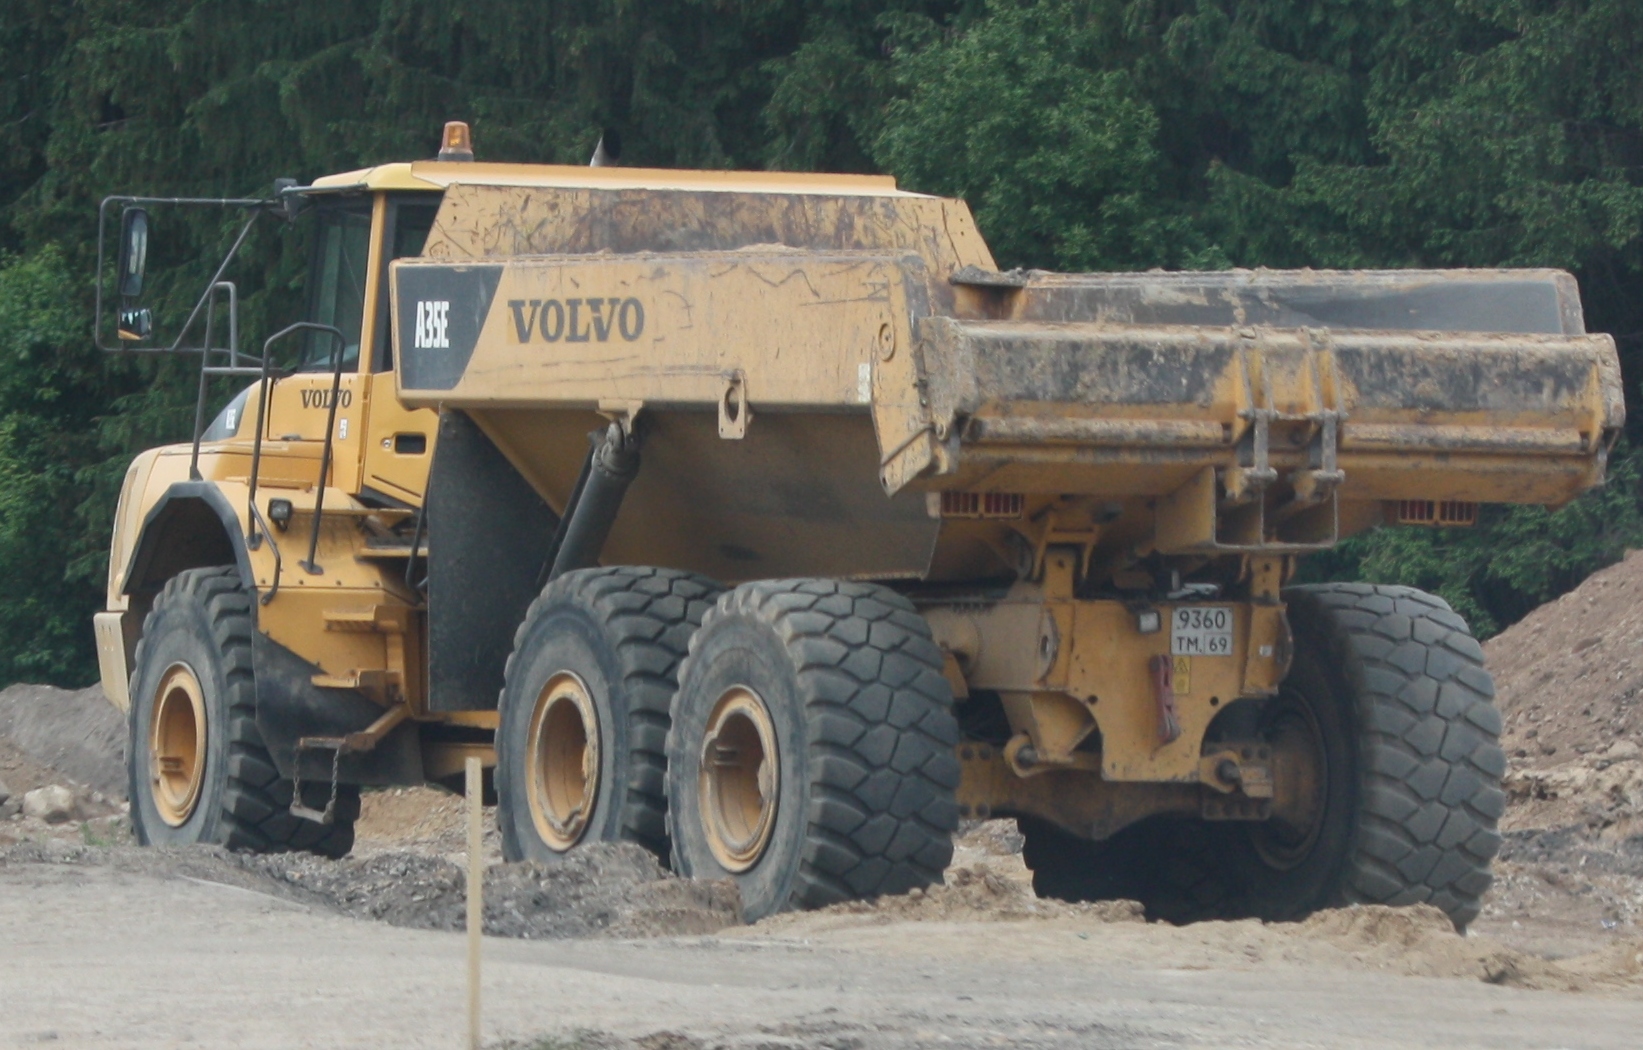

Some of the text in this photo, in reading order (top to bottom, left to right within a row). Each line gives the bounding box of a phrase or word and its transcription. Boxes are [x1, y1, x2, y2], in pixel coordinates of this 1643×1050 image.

[414, 300, 450, 348] A35E
[508, 297, 644, 344] VOLVO
[1179, 610, 1226, 629] 9360
[1209, 637, 1227, 652] 69
